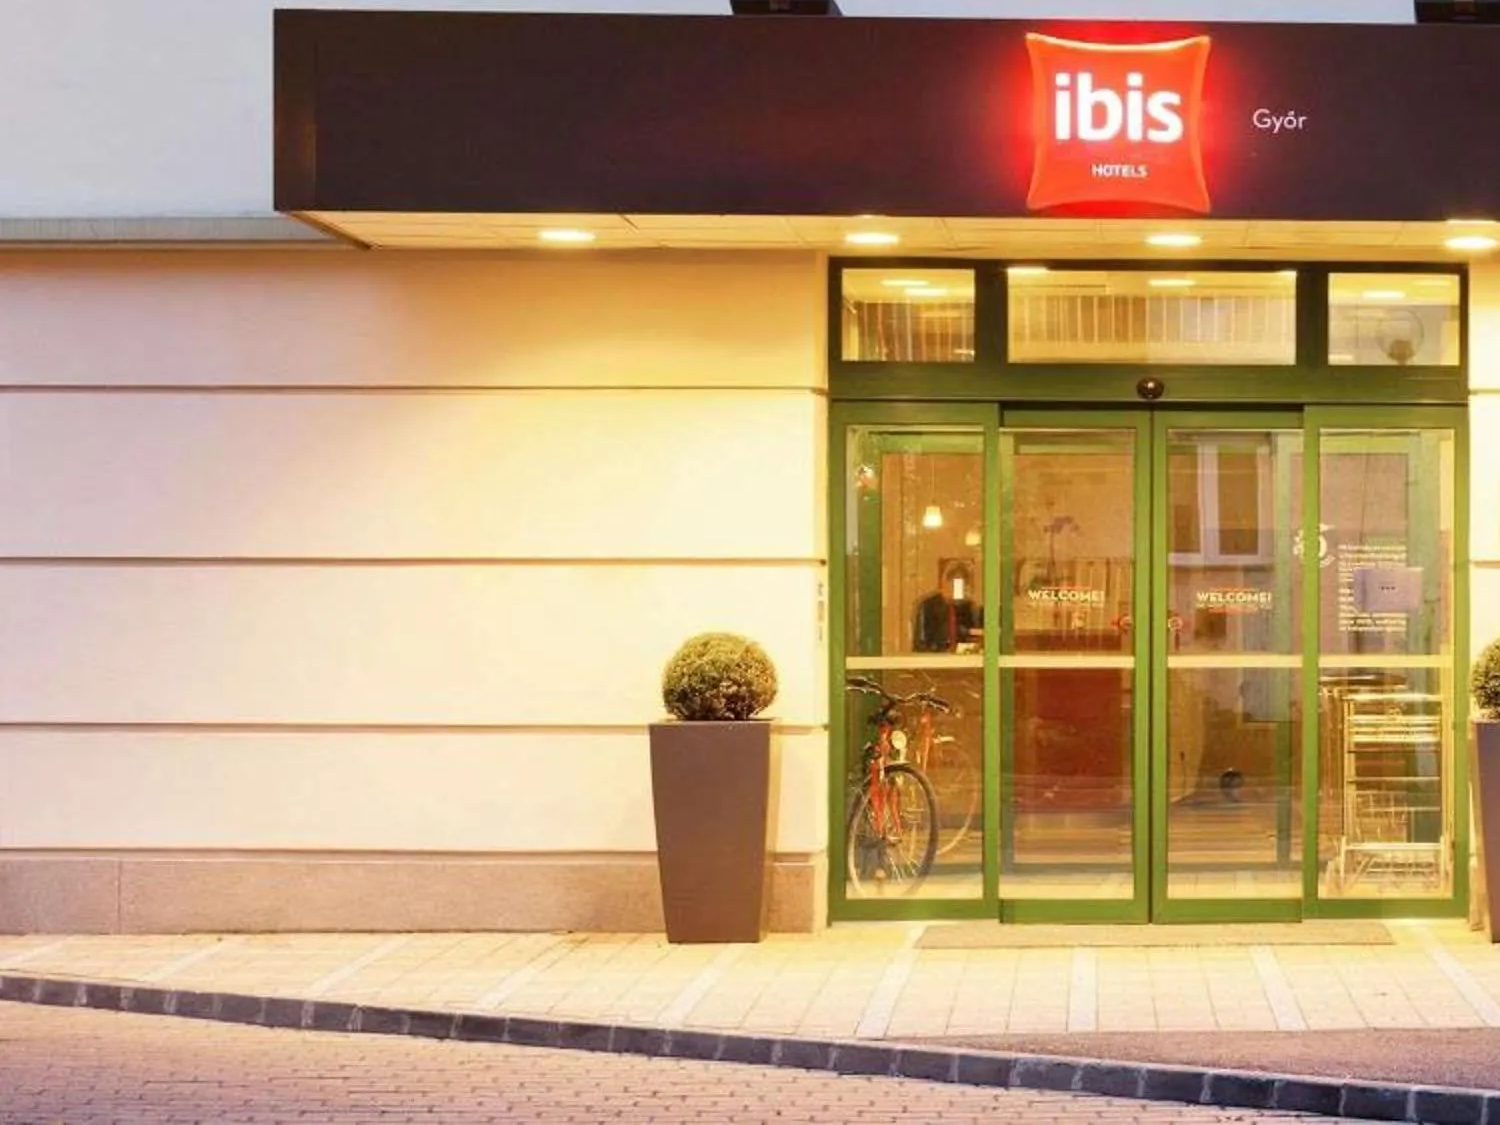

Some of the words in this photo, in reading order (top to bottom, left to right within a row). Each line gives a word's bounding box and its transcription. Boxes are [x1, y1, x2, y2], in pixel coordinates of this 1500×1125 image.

[1054, 71, 1184, 143] ibis
[1090, 163, 1149, 178] HOTELS
[1028, 589, 1105, 602] WELCOME!
[1196, 591, 1273, 604] WELCOME!
